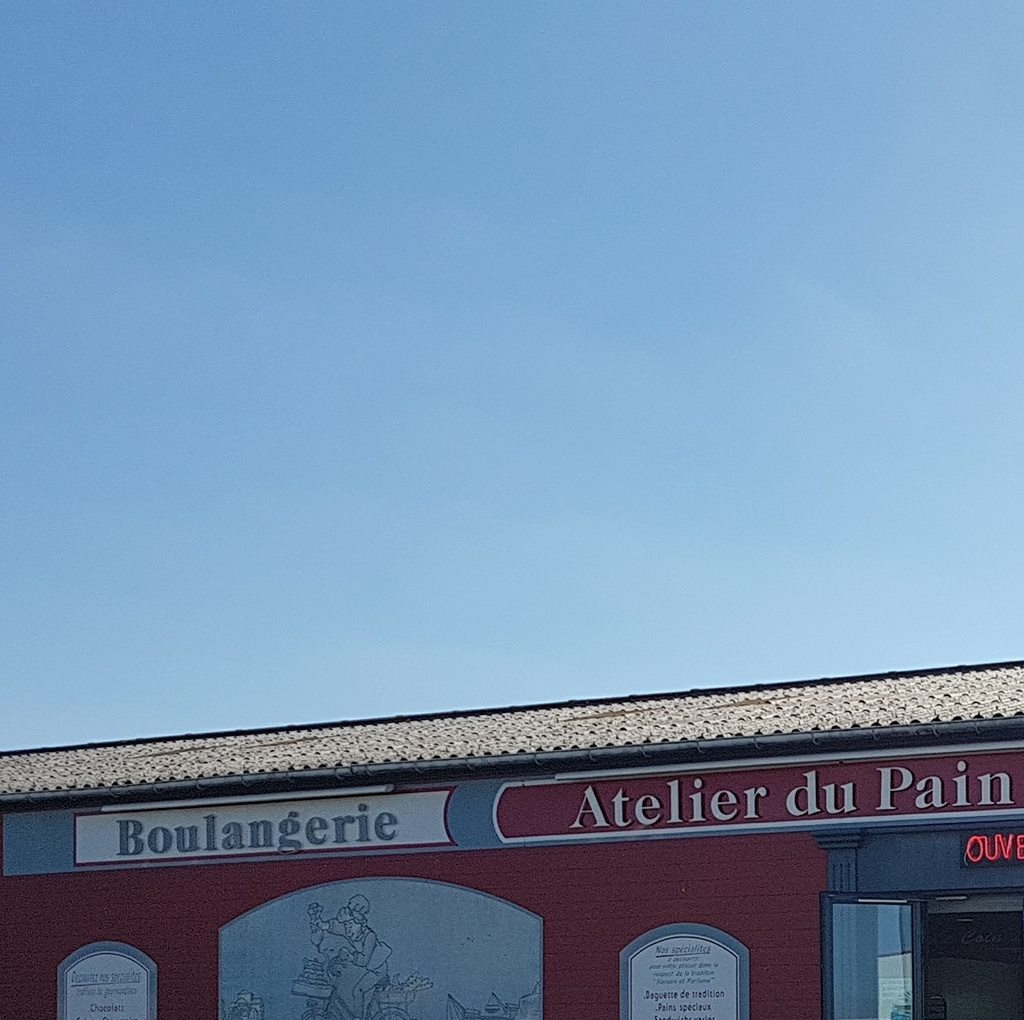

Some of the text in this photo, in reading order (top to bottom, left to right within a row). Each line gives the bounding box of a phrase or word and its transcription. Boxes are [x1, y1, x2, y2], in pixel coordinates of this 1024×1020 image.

[569, 778, 768, 829] Atelier
[785, 770, 857, 817] du
[875, 760, 1016, 811] Pain
[115, 803, 399, 854] Boulangerie
[680, 989, 690, 999] de
[692, 989, 725, 999] tradition
